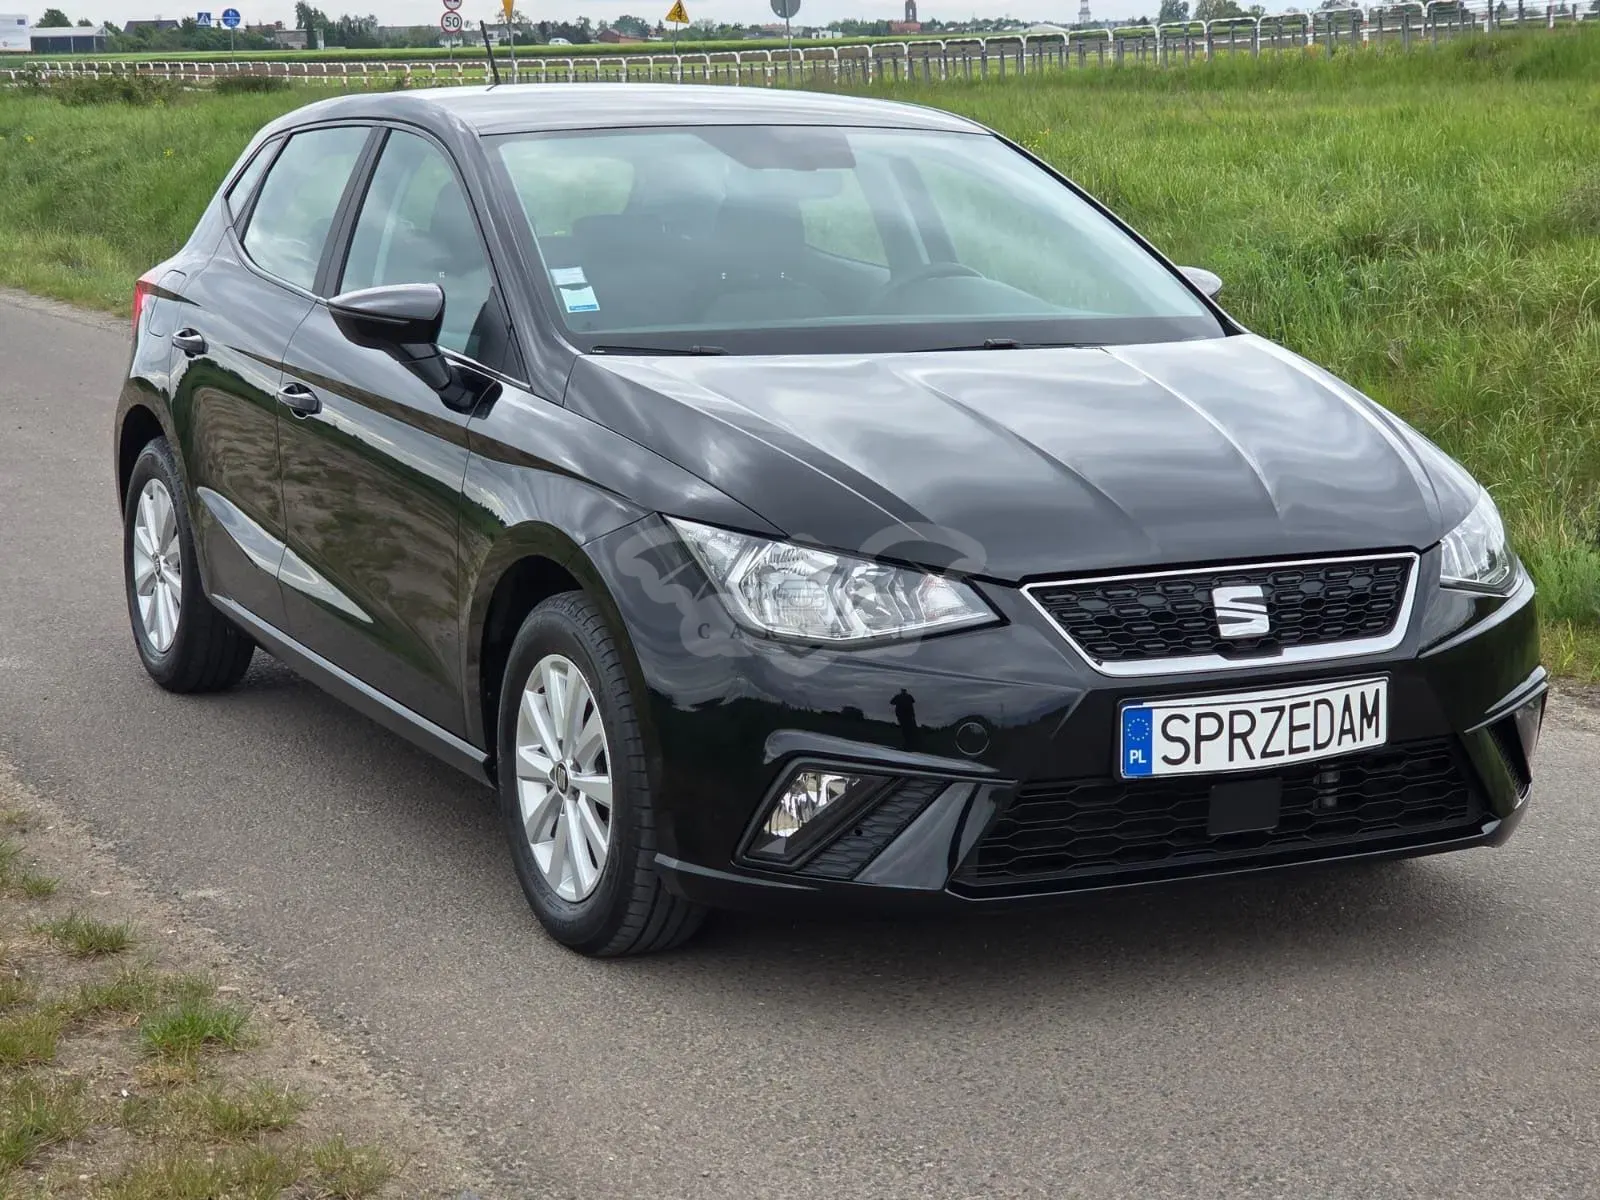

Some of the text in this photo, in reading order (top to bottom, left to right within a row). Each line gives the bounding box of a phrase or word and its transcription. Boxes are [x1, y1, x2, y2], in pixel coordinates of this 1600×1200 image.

[445, 16, 460, 28] 50
[1160, 688, 1381, 766] SPRZEDAM
[1129, 749, 1147, 764] PL
